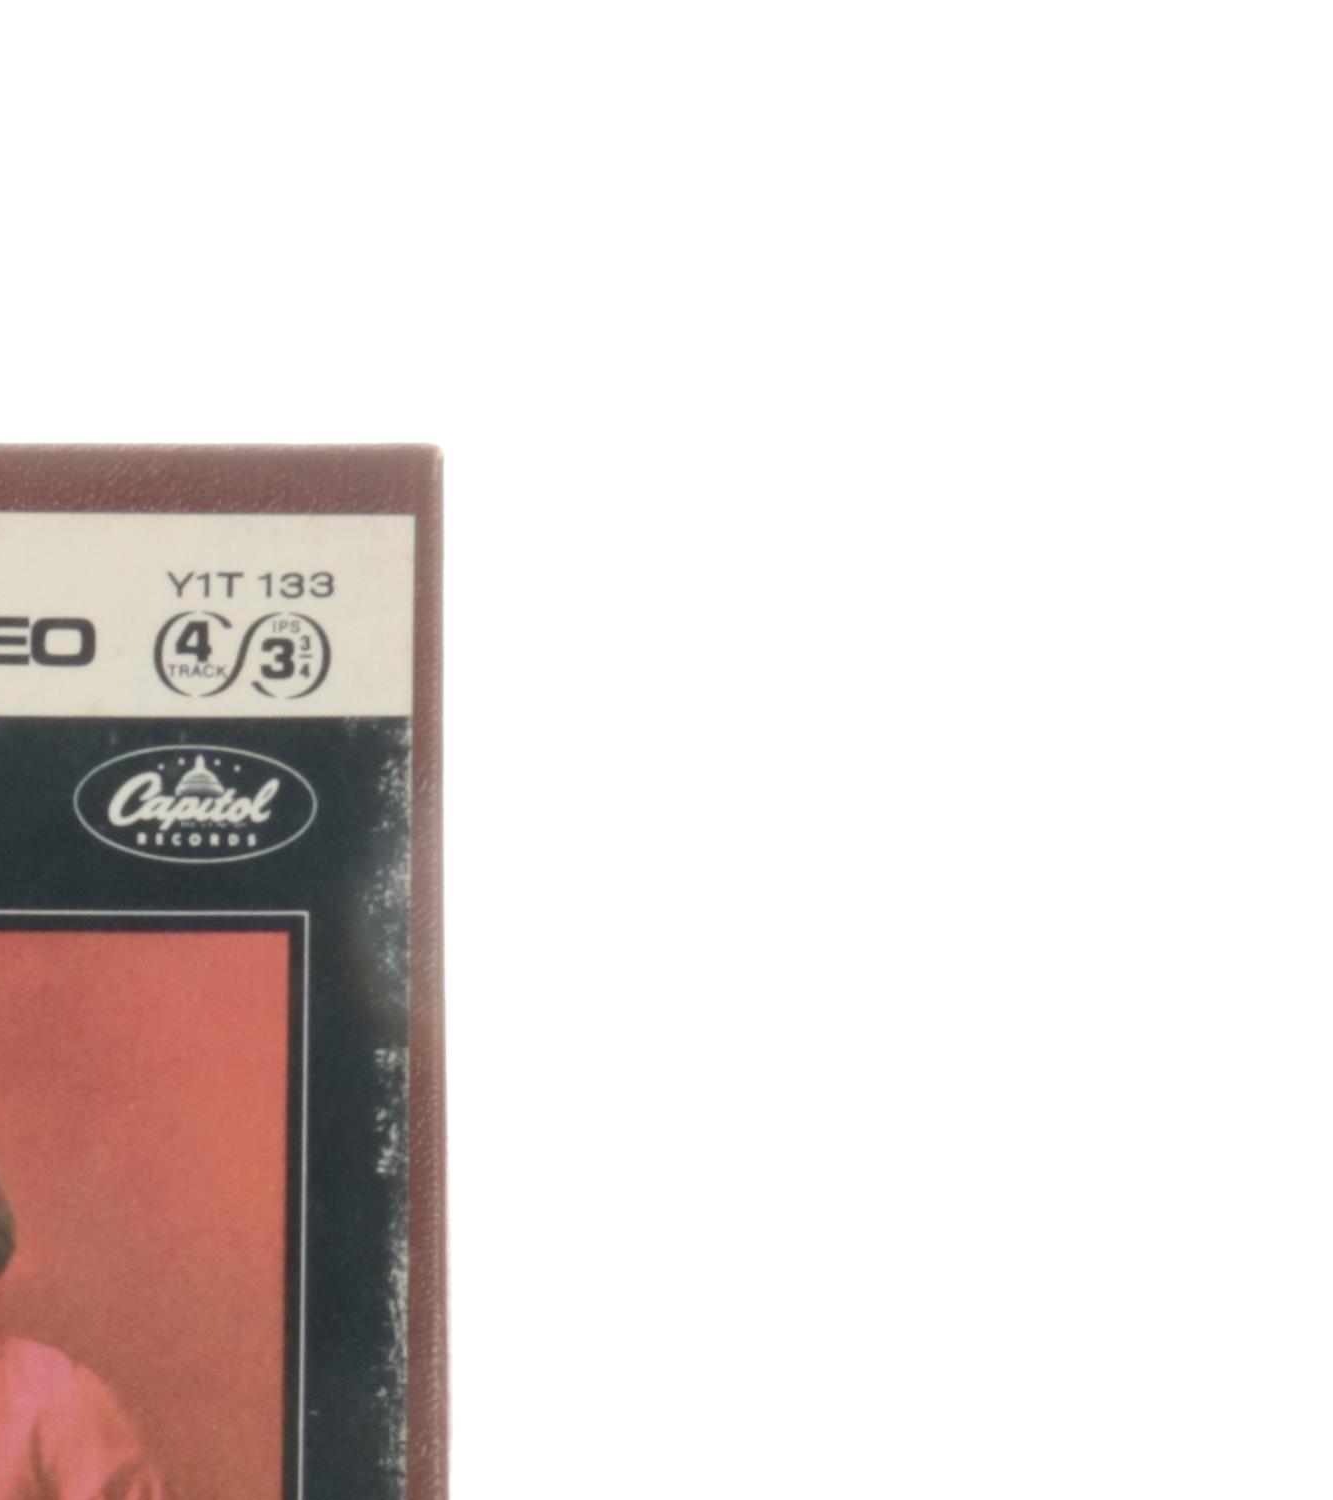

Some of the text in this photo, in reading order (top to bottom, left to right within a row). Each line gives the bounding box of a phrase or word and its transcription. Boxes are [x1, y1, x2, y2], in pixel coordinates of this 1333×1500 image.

[167, 571, 334, 599] Y1T 133
[272, 619, 302, 634] IPS
[175, 620, 212, 663] 4
[167, 663, 228, 678] TRACK
[107, 770, 280, 831] Capitol
[136, 831, 258, 847] RECORDS
